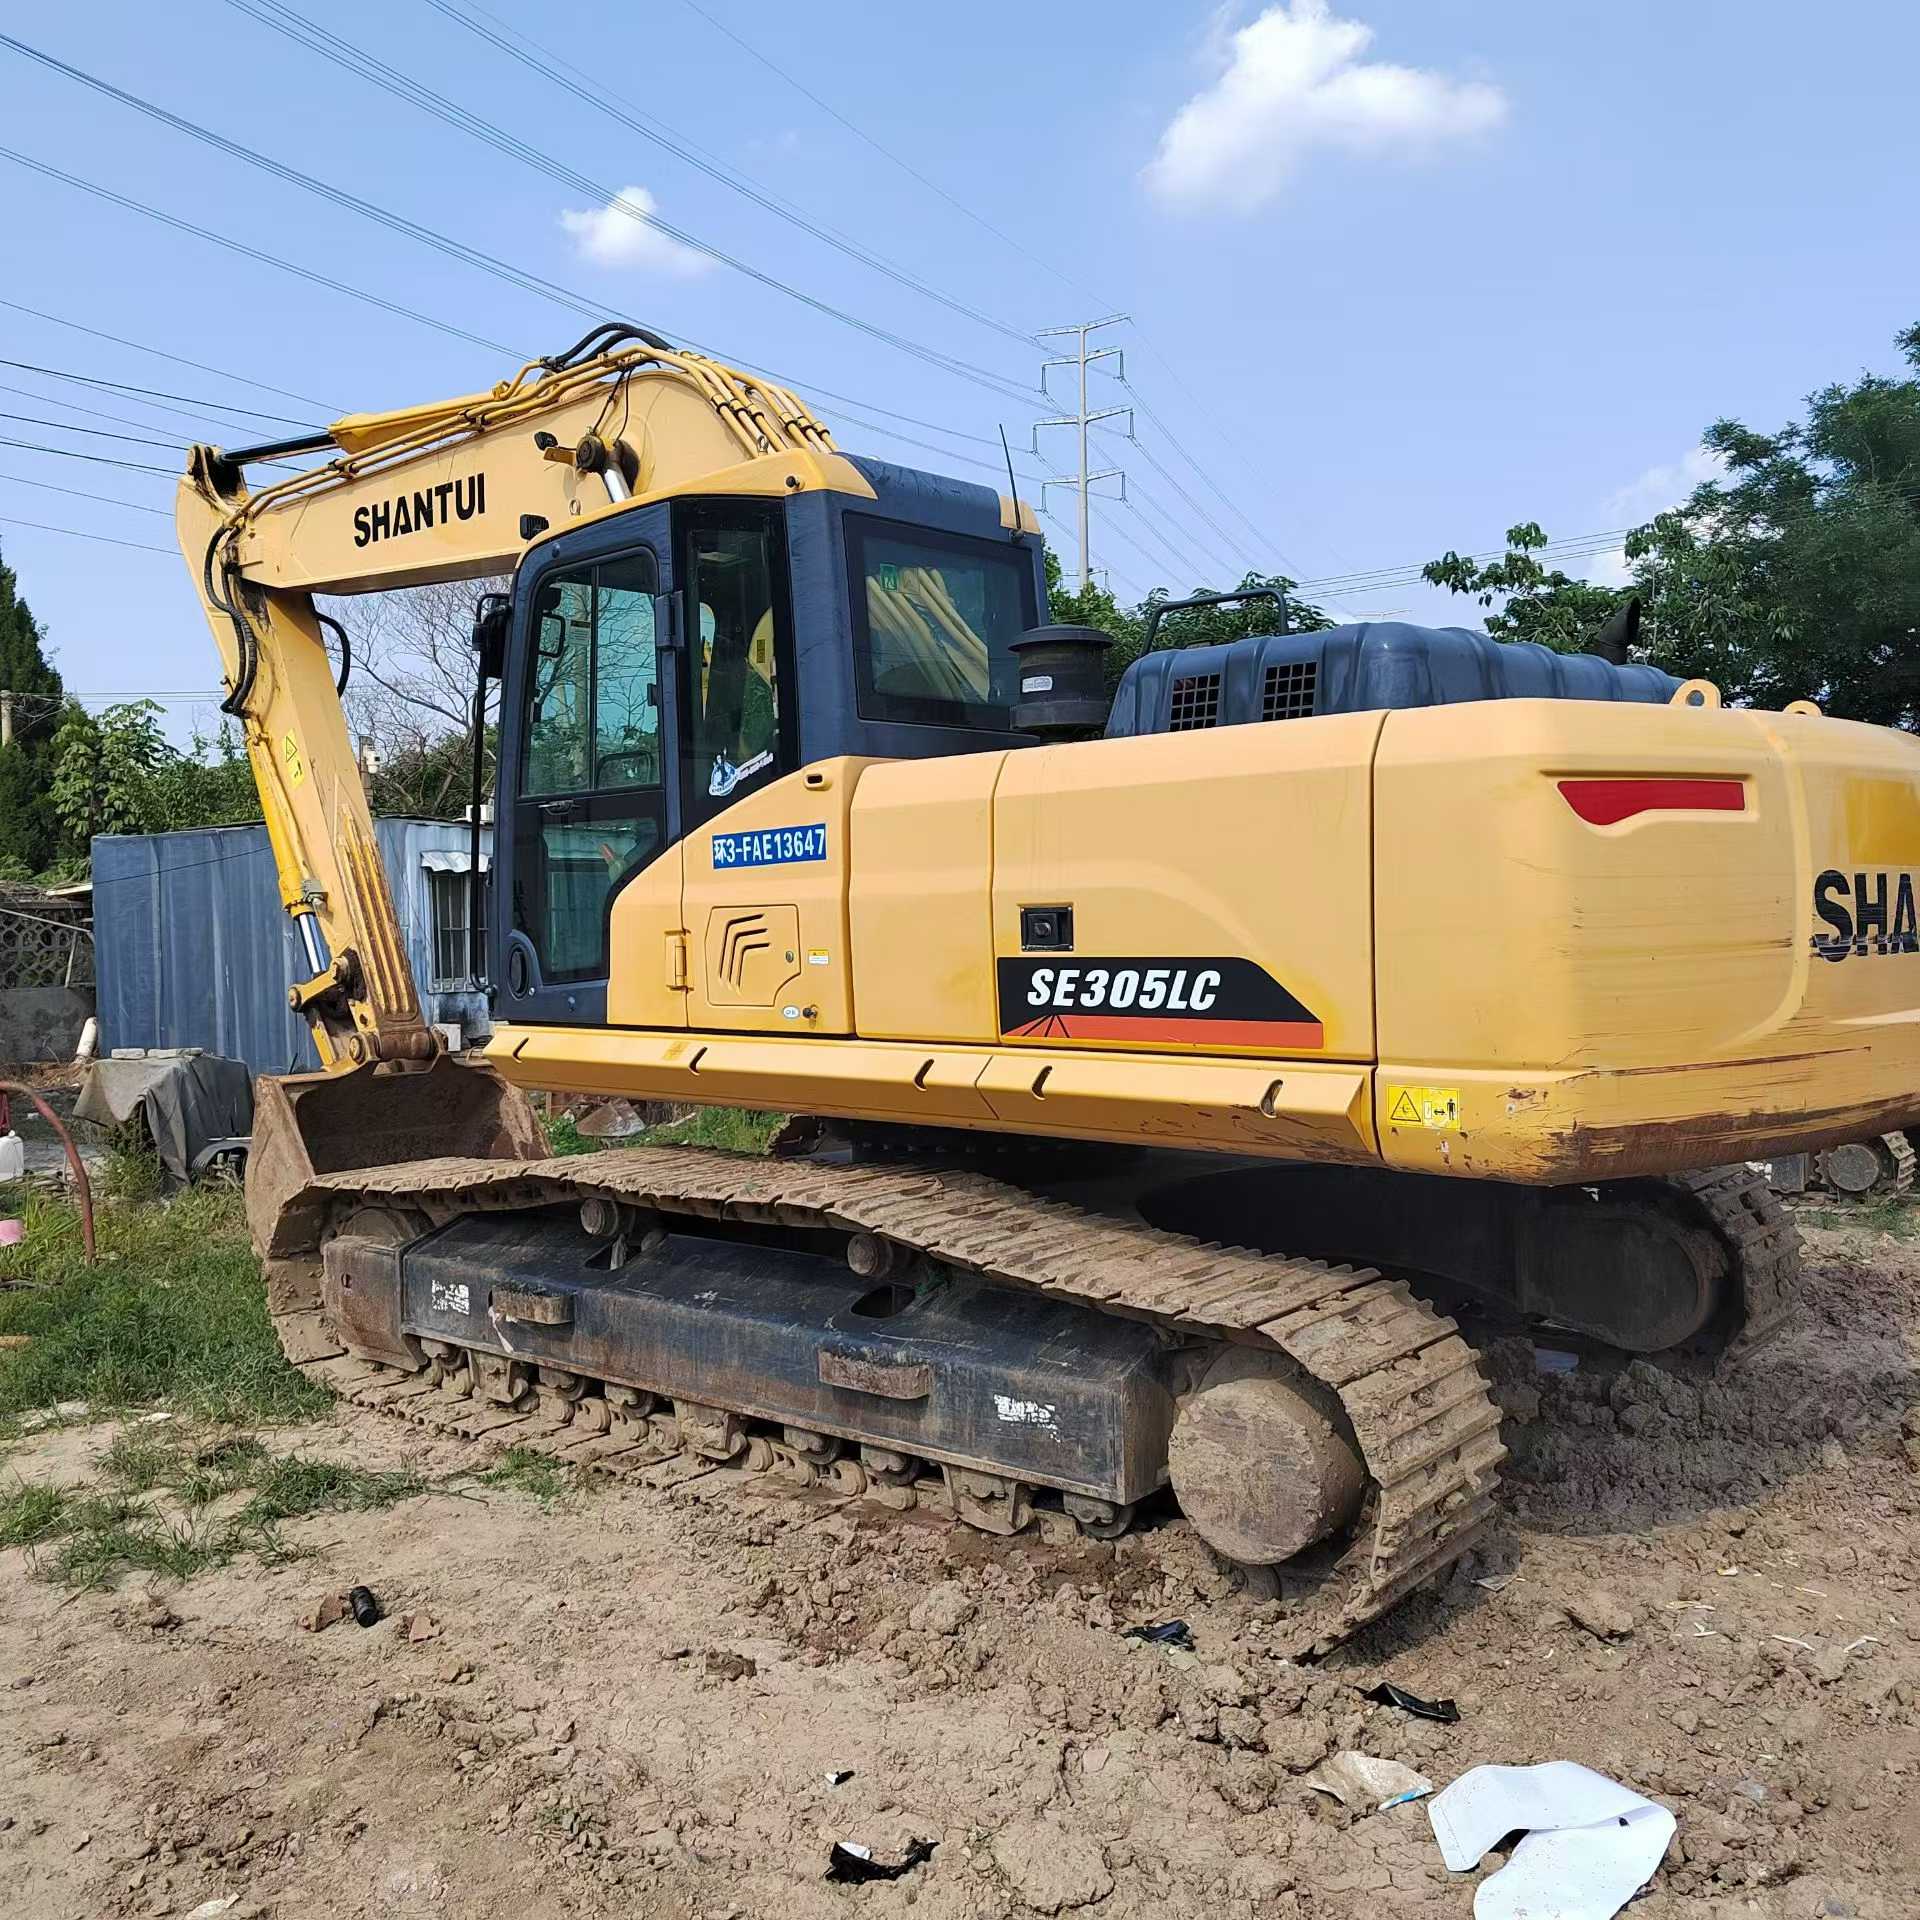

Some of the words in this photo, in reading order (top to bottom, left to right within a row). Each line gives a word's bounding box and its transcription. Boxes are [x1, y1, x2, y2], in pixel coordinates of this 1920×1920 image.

[353, 472, 486, 548] SHANTUI
[713, 828, 825, 864] 环3-FAE13647
[1813, 869, 1920, 963] SHA
[1027, 968, 1221, 1011] SE305LC
